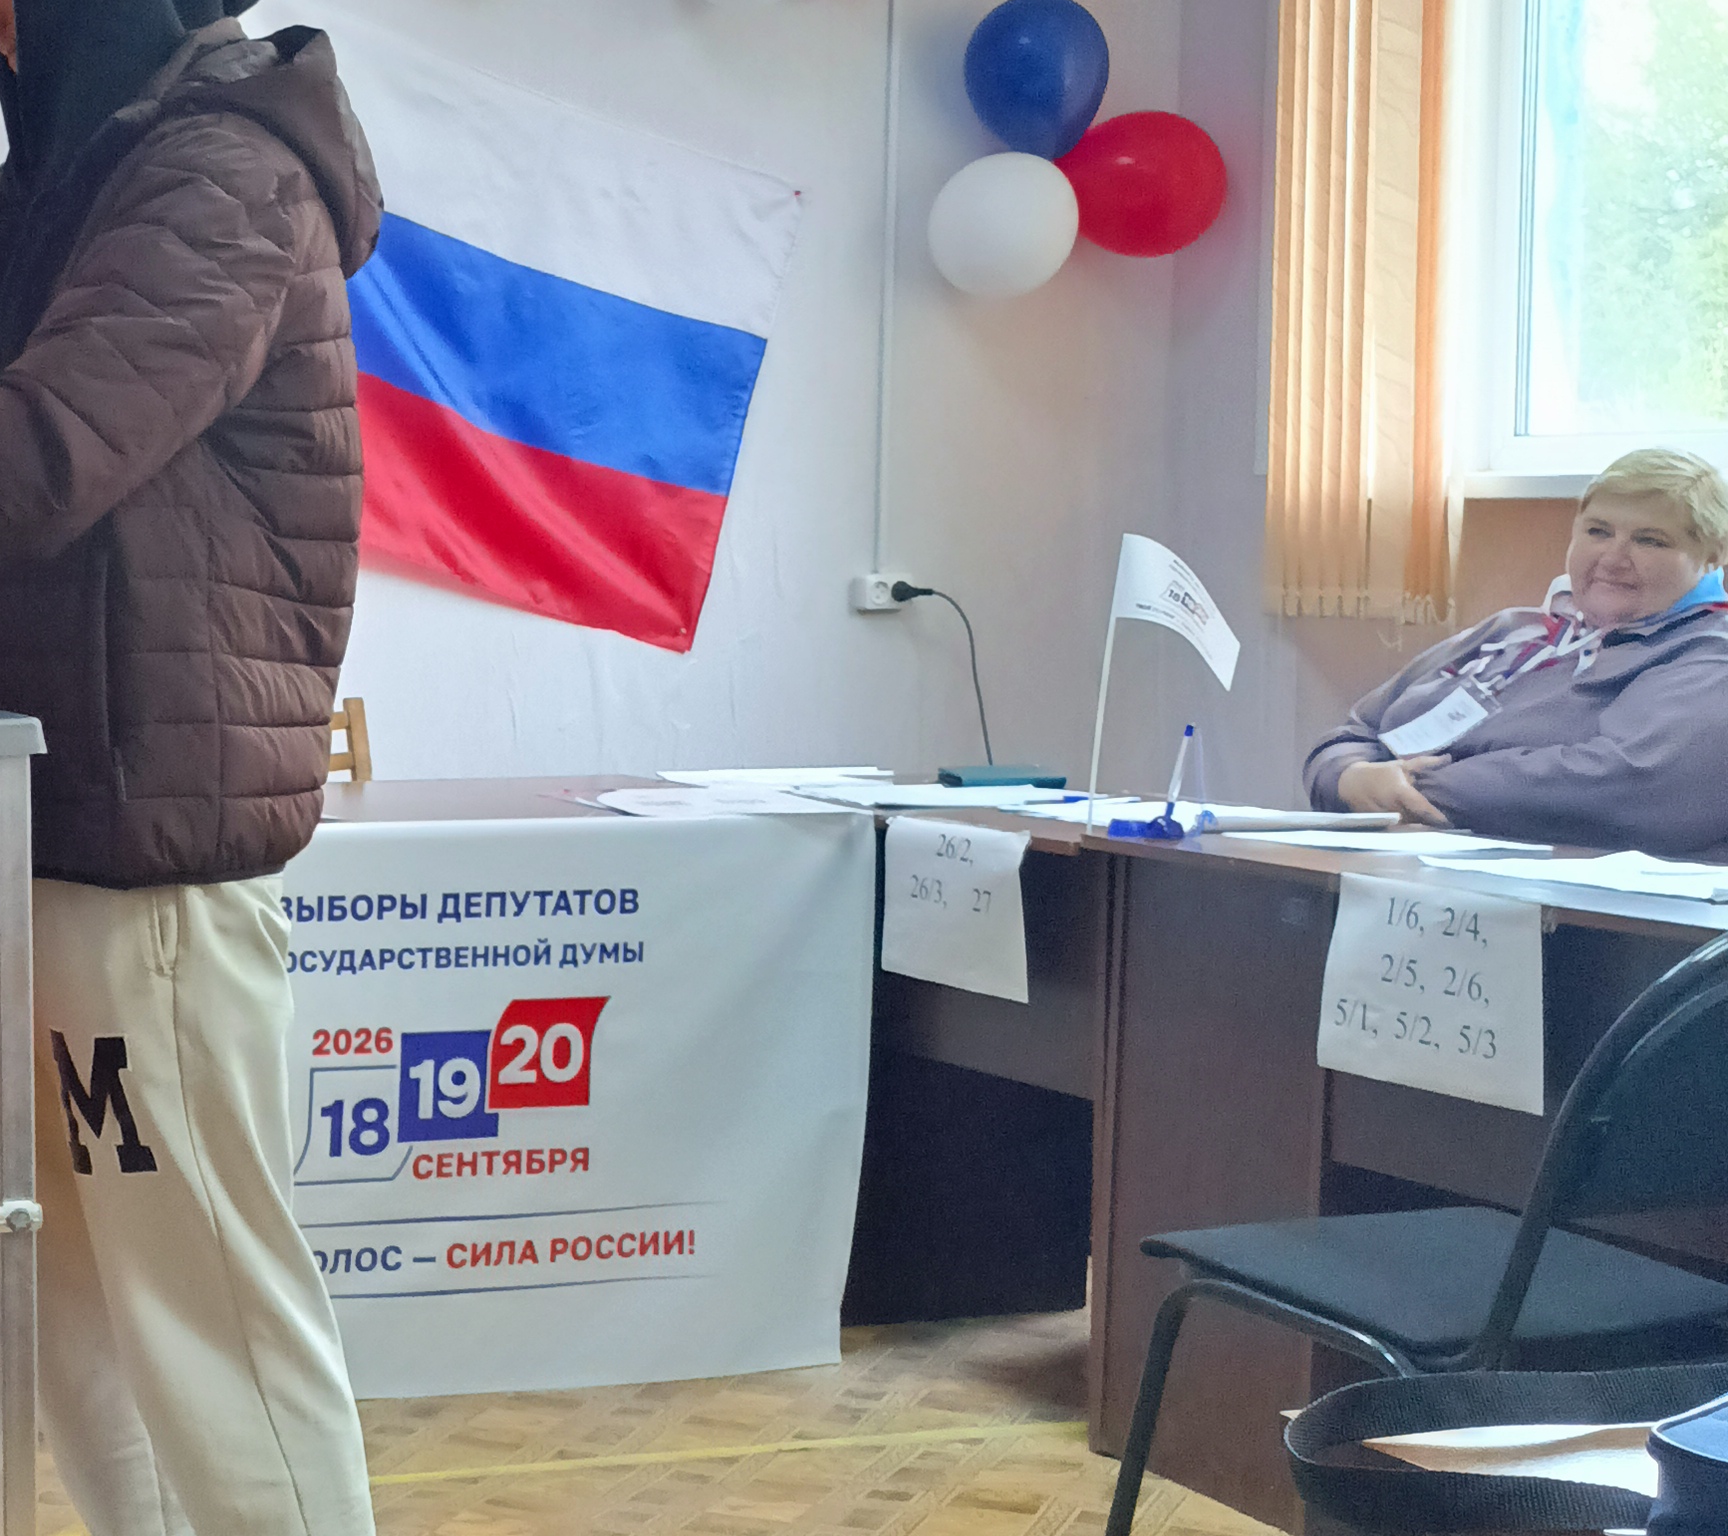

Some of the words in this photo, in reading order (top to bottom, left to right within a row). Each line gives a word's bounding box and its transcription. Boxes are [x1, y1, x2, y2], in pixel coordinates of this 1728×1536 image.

[936, 834, 974, 864] 26/2,
[437, 888, 640, 924] ДЕПУТАТОВ
[910, 874, 948, 909] 26/3,
[972, 888, 991, 913] 27
[1387, 896, 1424, 937] 1/6,
[1442, 907, 1488, 948] 2/4,
[286, 937, 552, 976] ОСУДАРСТВЕННОЙ
[558, 941, 644, 969] ДУМЫ
[1381, 953, 1425, 994] 2/5,
[1443, 966, 1490, 1008] 2/6,
[312, 1027, 394, 1056] 2026
[1334, 998, 1378, 1037] 5/1,
[1394, 1012, 1440, 1050] 5/2,
[1458, 1025, 1497, 1059] 5/3
[49, 1028, 158, 1175] M
[320, 1097, 390, 1157] 18
[409, 1057, 481, 1120] 19
[498, 1022, 585, 1085] 20
[412, 1147, 590, 1180] СЕНТЯБРЯ
[314, 1245, 403, 1275] ОЛОС
[446, 1239, 539, 1269] СИЛА
[549, 1229, 696, 1263] РОССИИ!
